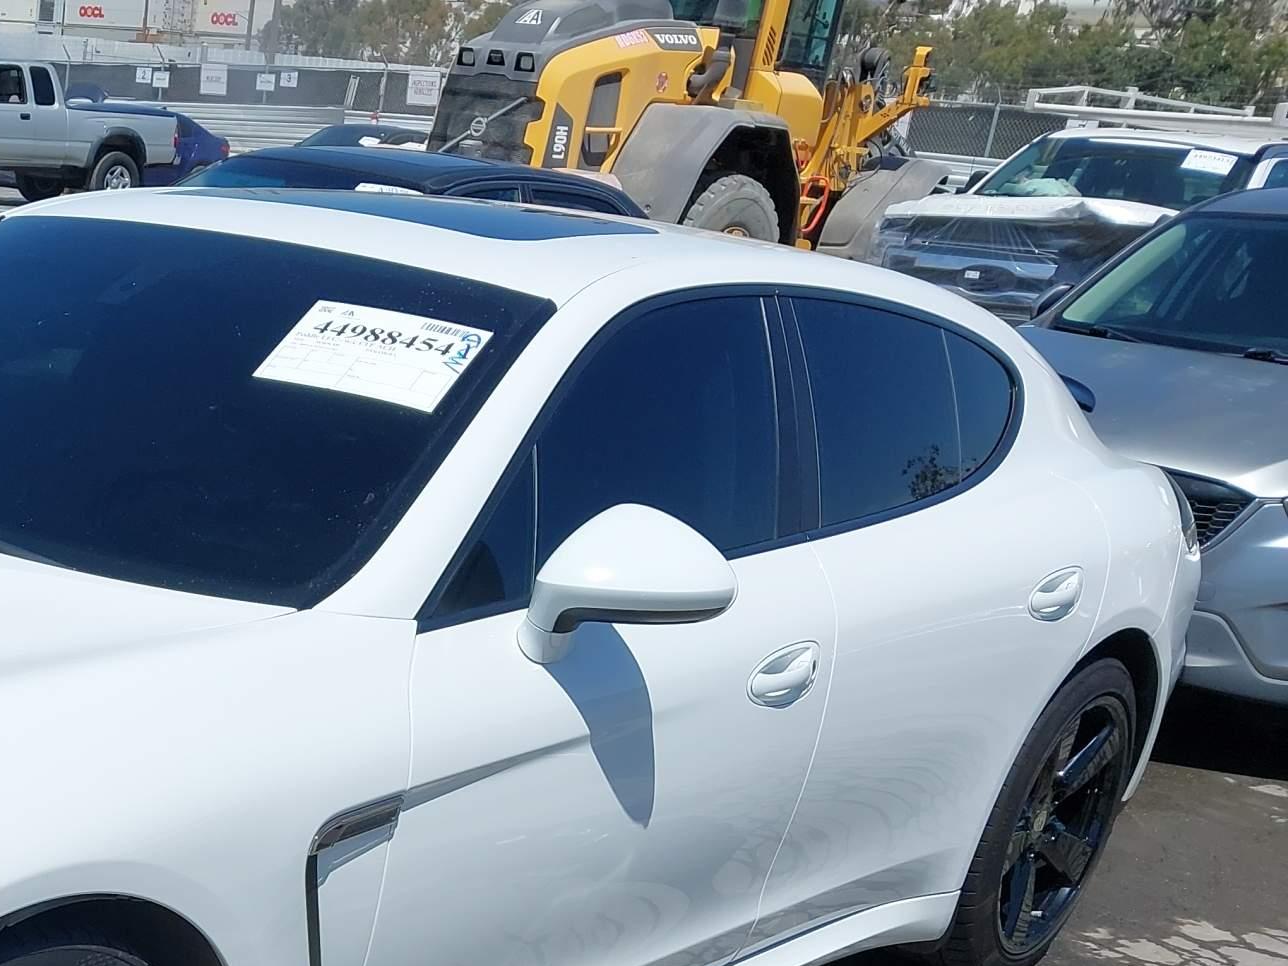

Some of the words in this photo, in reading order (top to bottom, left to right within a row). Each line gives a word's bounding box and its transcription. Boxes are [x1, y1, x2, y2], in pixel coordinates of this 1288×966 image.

[79, 6, 104, 18] OOCL
[211, 12, 238, 26] OOCL
[654, 33, 697, 45] VOLVO
[552, 126, 569, 159] L90H
[313, 320, 456, 356] 44988454
